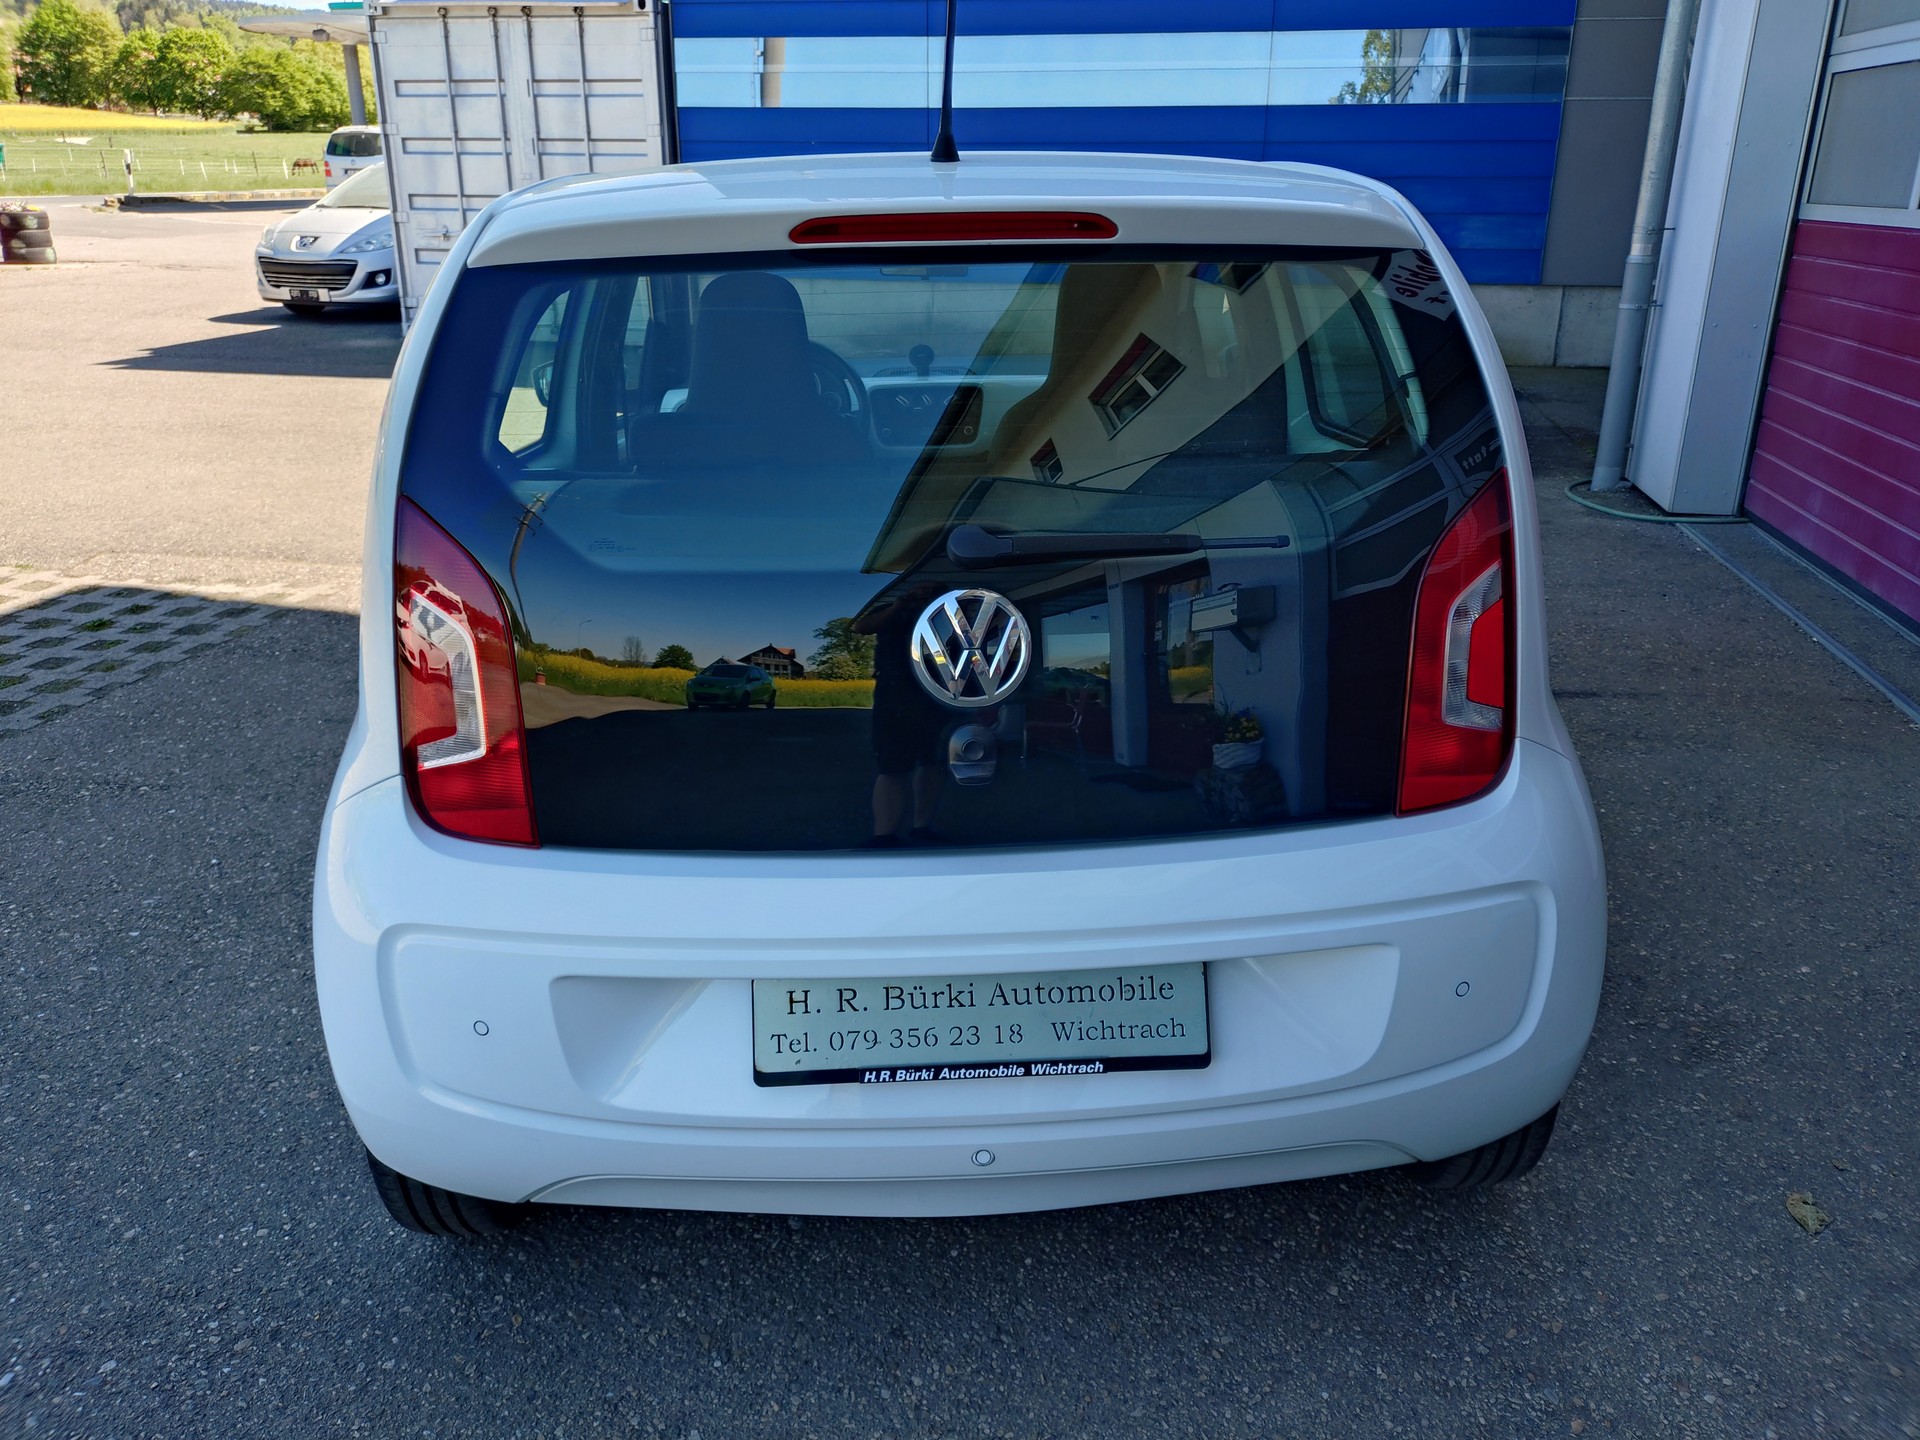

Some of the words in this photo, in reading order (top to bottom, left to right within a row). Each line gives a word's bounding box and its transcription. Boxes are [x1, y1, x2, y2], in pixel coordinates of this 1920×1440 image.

[786, 989, 821, 1015] H.
[836, 988, 868, 1013] R.
[883, 982, 976, 1011] Bürki
[988, 975, 1175, 1007] Automobile
[770, 1031, 818, 1054] Tel.
[829, 1029, 879, 1051] 079
[889, 1026, 938, 1049] 356
[949, 1025, 980, 1046] 23
[995, 1023, 1023, 1044] 18
[1051, 1017, 1186, 1042] Wichtrach
[938, 1064, 1025, 1080] Automobile
[1031, 1061, 1104, 1076] Wichtrach
